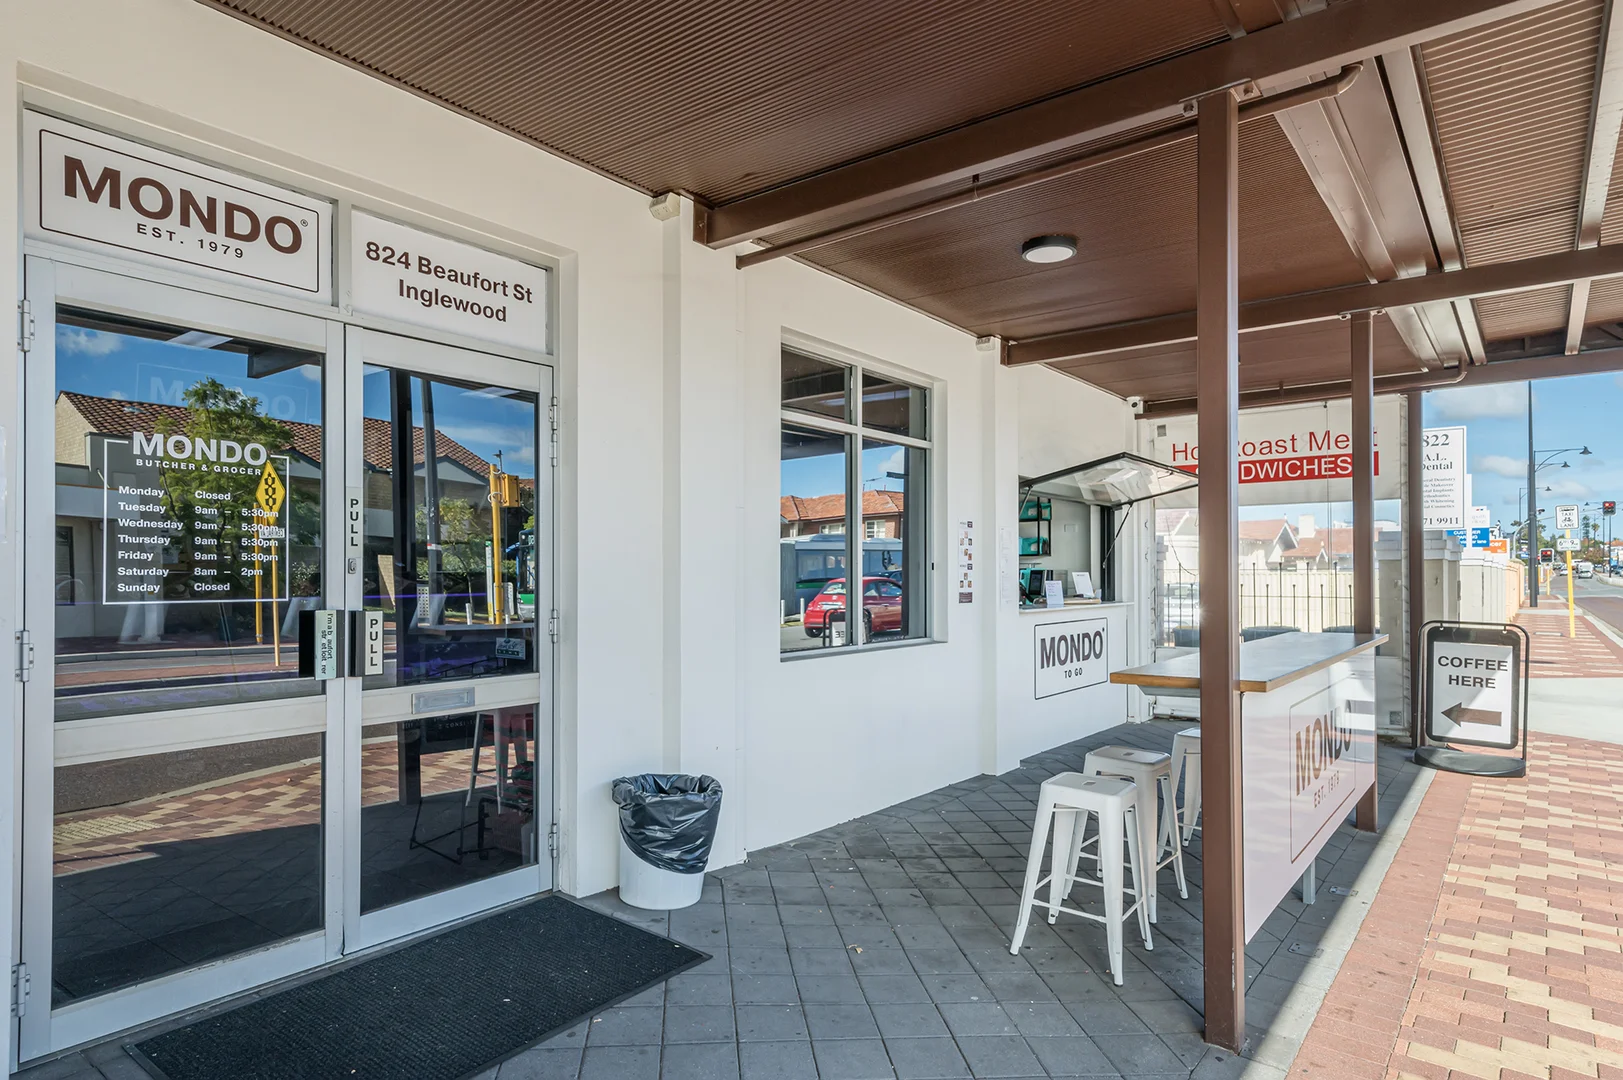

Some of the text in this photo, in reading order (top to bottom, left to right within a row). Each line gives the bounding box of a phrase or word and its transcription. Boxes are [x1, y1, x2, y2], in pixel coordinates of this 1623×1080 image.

[137, 222, 244, 259] EST. 1979
[366, 241, 533, 304] 824 Beaufort St
[399, 279, 507, 322] Inglewood
[132, 431, 268, 467] MONDO
[1173, 441, 1198, 462] Ho
[1237, 433, 1298, 457] oast
[136, 458, 196, 471] BUTCHER
[213, 465, 262, 476] GROCER
[118, 486, 232, 501] Monday Closed
[118, 502, 166, 514] Tuesday
[194, 506, 218, 515] 9am
[241, 509, 279, 518] 5:30pm
[118, 518, 184, 531] Wednesday
[194, 522, 218, 530] 9am
[241, 523, 279, 532] 5:30pm
[350, 498, 359, 547] PULL
[1437, 517, 1459, 525] 9911
[118, 534, 171, 546] Thursday
[194, 537, 218, 546] 9am
[241, 538, 279, 548] 5:30pm
[118, 551, 154, 563] Friday
[194, 552, 218, 561] 9am
[241, 553, 279, 563] 5:30pm
[117, 567, 170, 578] Saturday
[194, 568, 218, 577] 8am
[240, 568, 263, 577] 2pm
[117, 583, 231, 594] Sunday Closed
[369, 618, 379, 667] PULL
[1438, 655, 1508, 671] COFFEE
[1064, 667, 1083, 679] TO GO
[1448, 674, 1496, 689] HERE
[1296, 699, 1352, 796] MONDO
